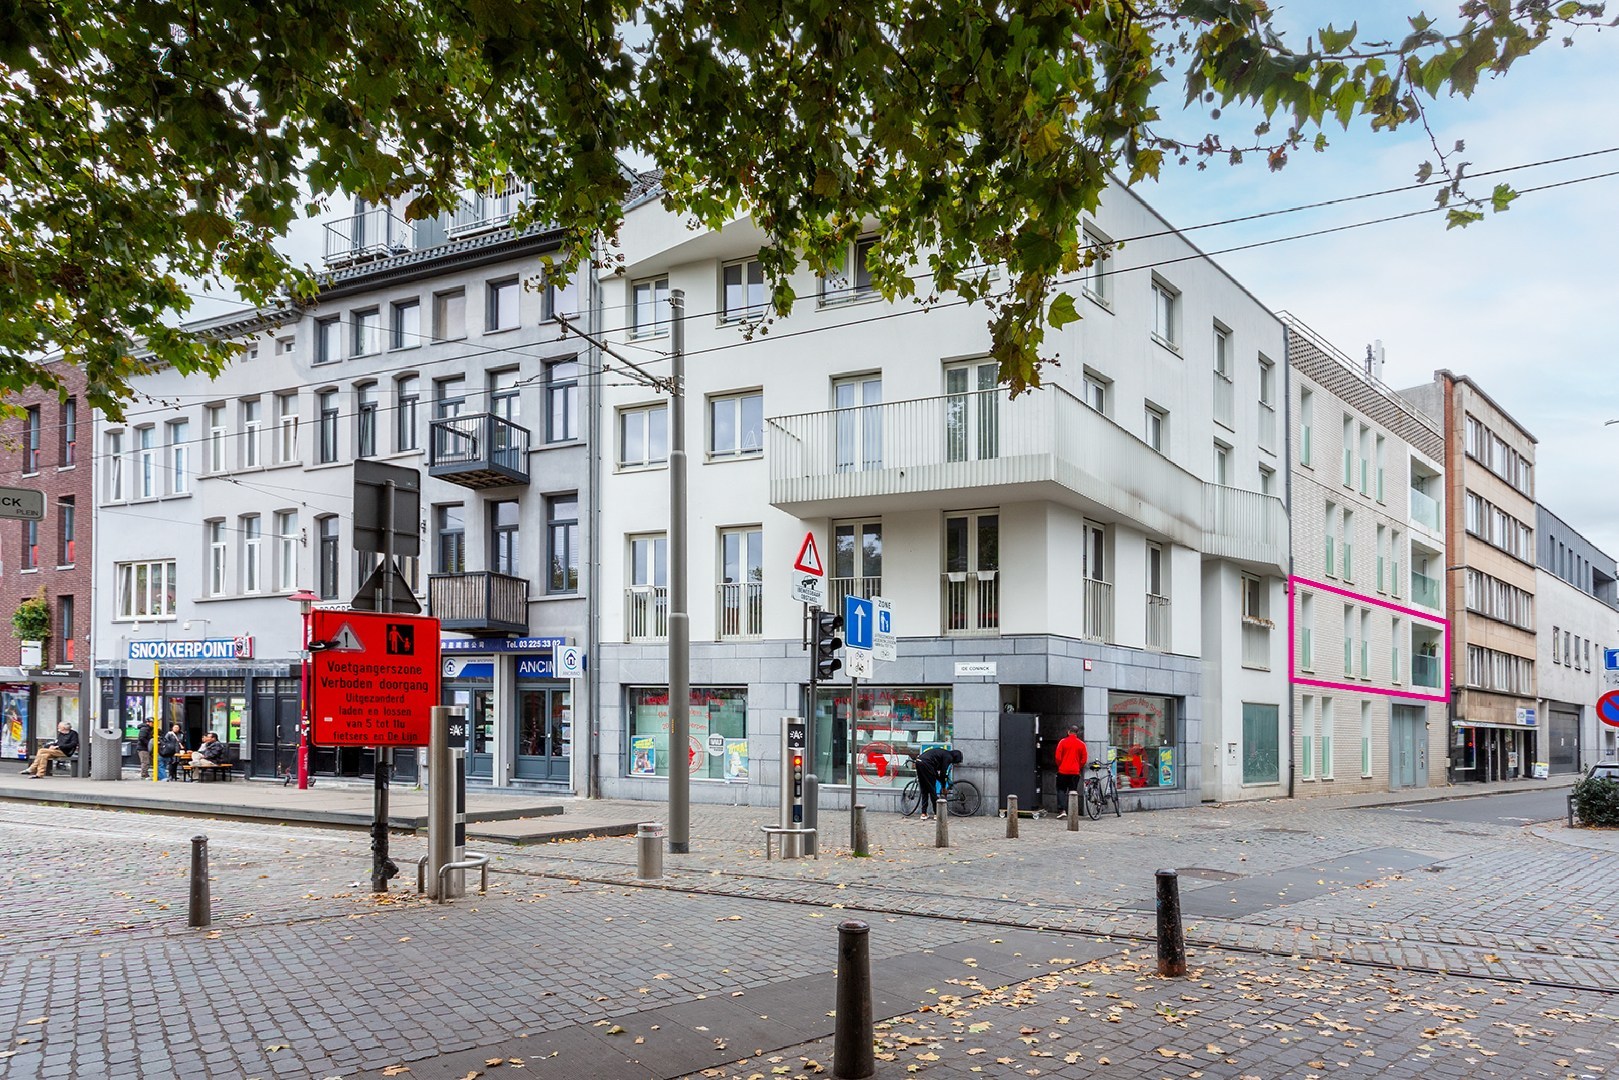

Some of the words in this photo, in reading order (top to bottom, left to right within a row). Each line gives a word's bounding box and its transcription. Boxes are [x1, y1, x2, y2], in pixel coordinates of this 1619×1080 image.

[878, 600, 892, 610] ZONE
[131, 641, 234, 658] SNOOKERPOINT
[528, 640, 541, 648] 225
[542, 640, 551, 648] 33
[327, 661, 422, 676] Voetgangerszone
[320, 676, 373, 688] Verboden
[379, 678, 429, 692] doorgang
[346, 692, 405, 704] Uitgezonderd
[338, 706, 363, 716] laden
[384, 707, 412, 716] lossen
[366, 719, 372, 728] 5
[376, 720, 389, 728] tot
[333, 731, 368, 740] fietsers
[388, 732, 398, 740] De
[402, 732, 418, 742] Lijn
